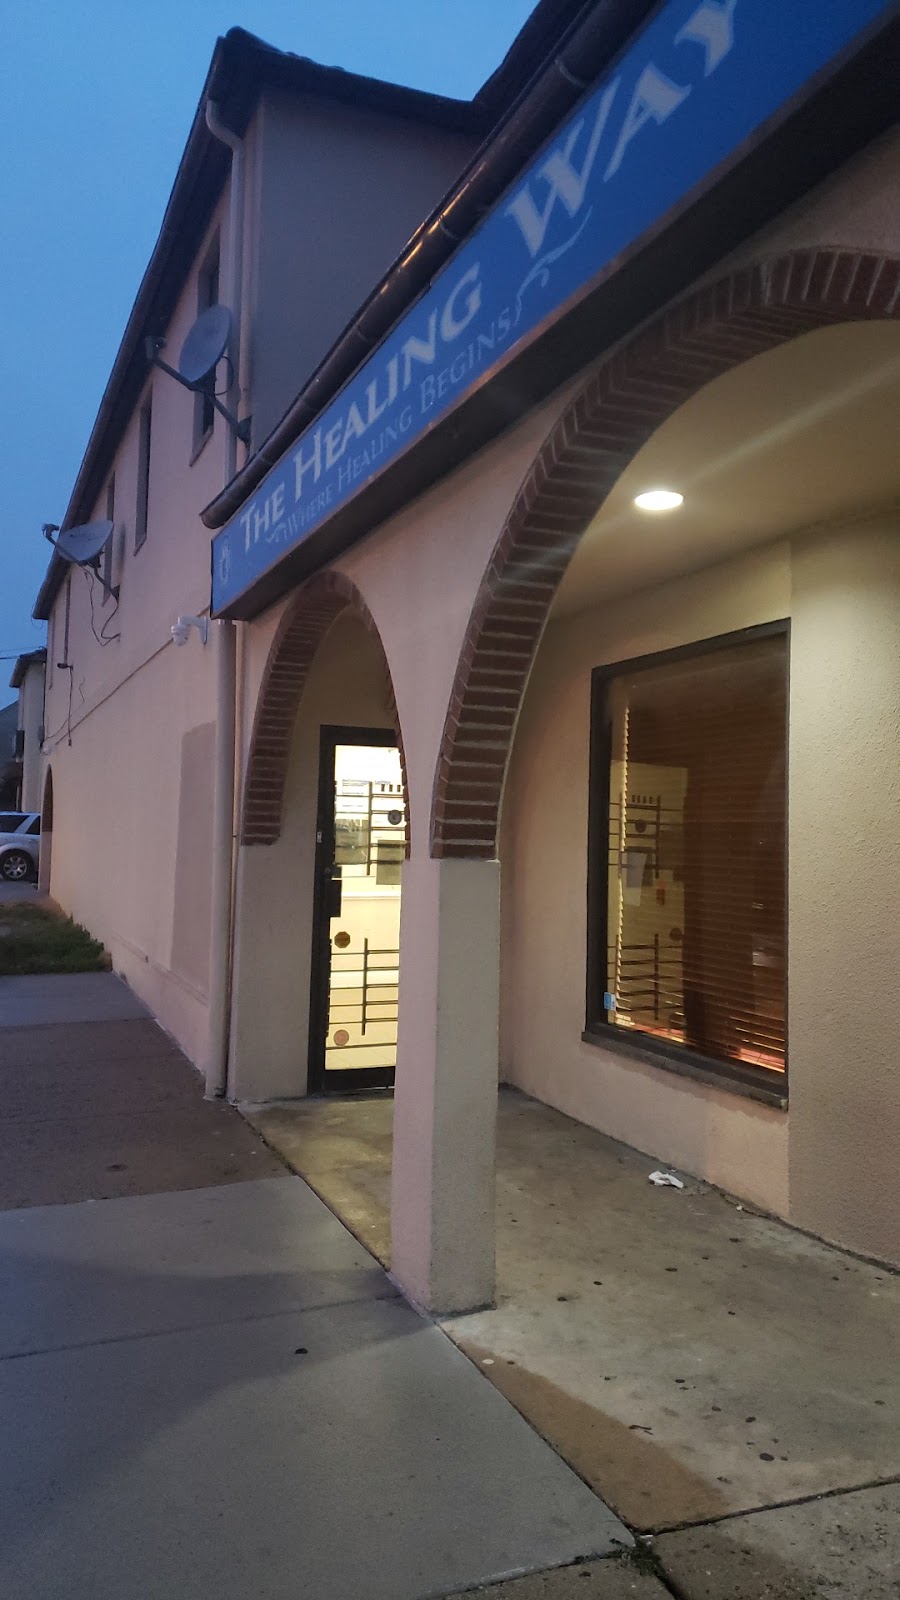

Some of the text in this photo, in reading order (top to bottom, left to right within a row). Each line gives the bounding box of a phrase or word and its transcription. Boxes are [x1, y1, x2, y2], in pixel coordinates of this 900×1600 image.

[239, 0, 738, 554] THE HEALING WAY
[287, 306, 511, 537] WHERE HEALING BEGINS
